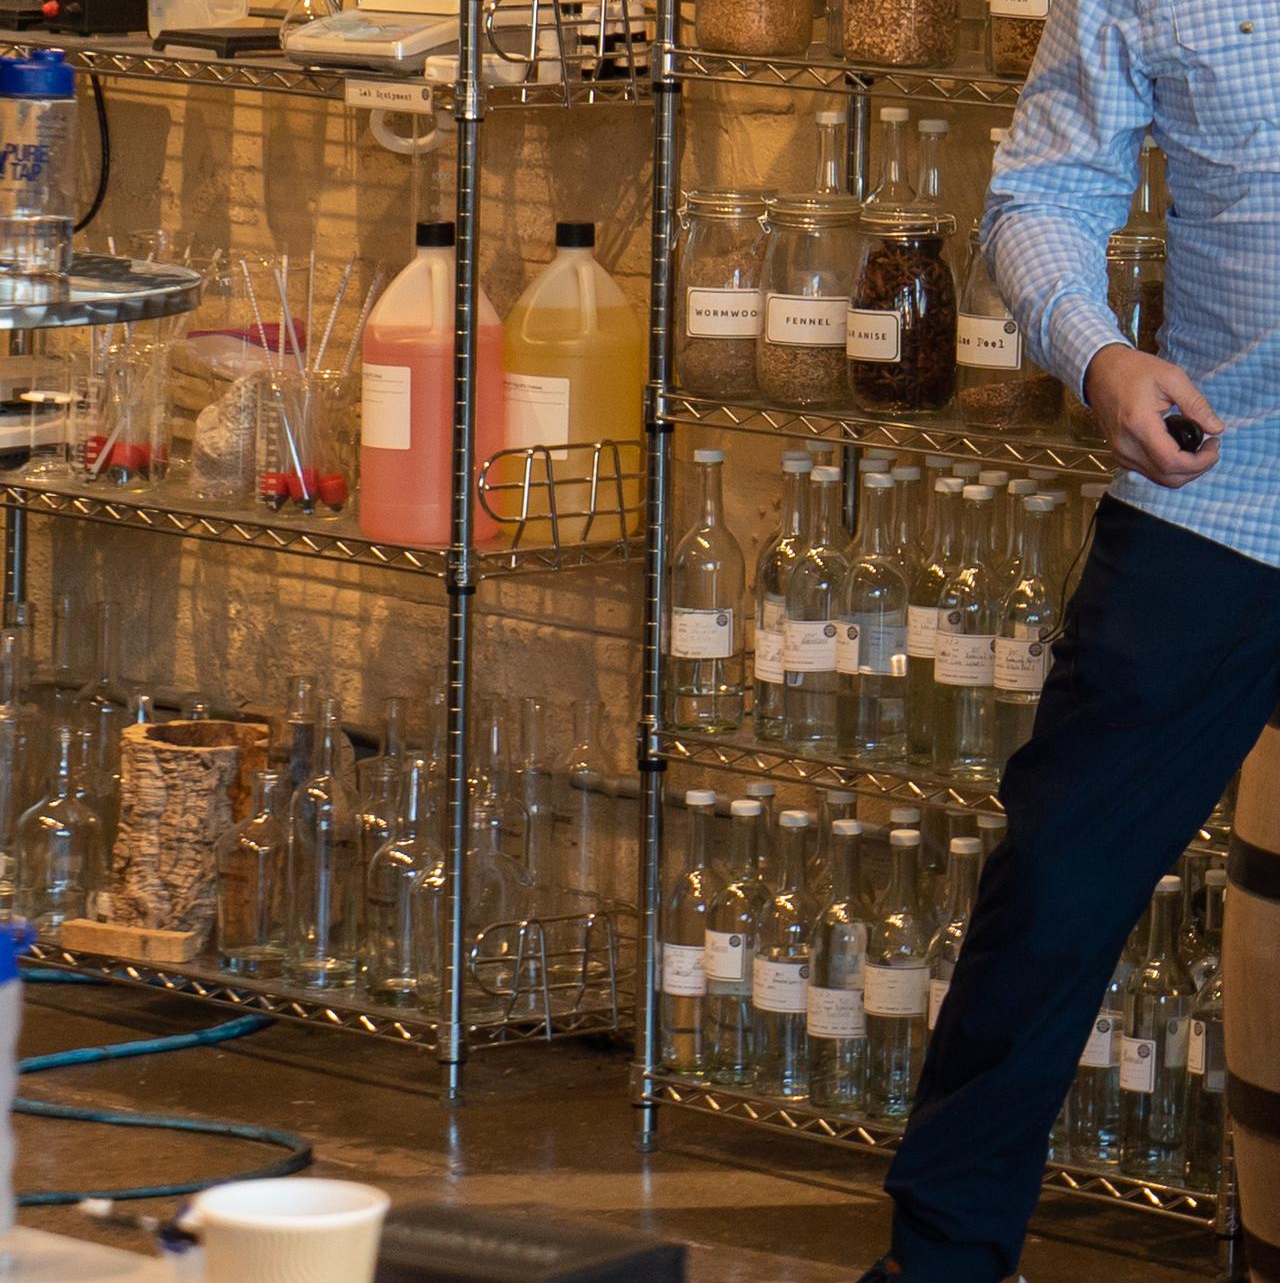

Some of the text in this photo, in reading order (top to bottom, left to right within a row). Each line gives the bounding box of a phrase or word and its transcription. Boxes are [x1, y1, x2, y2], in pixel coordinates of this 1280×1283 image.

[5, 143, 49, 163] PURE
[12, 162, 42, 181] TAP
[695, 308, 758, 318] WORMWOO
[785, 316, 832, 327] FENNEL
[857, 331, 888, 341] ANISE
[976, 337, 1006, 349] Peel
